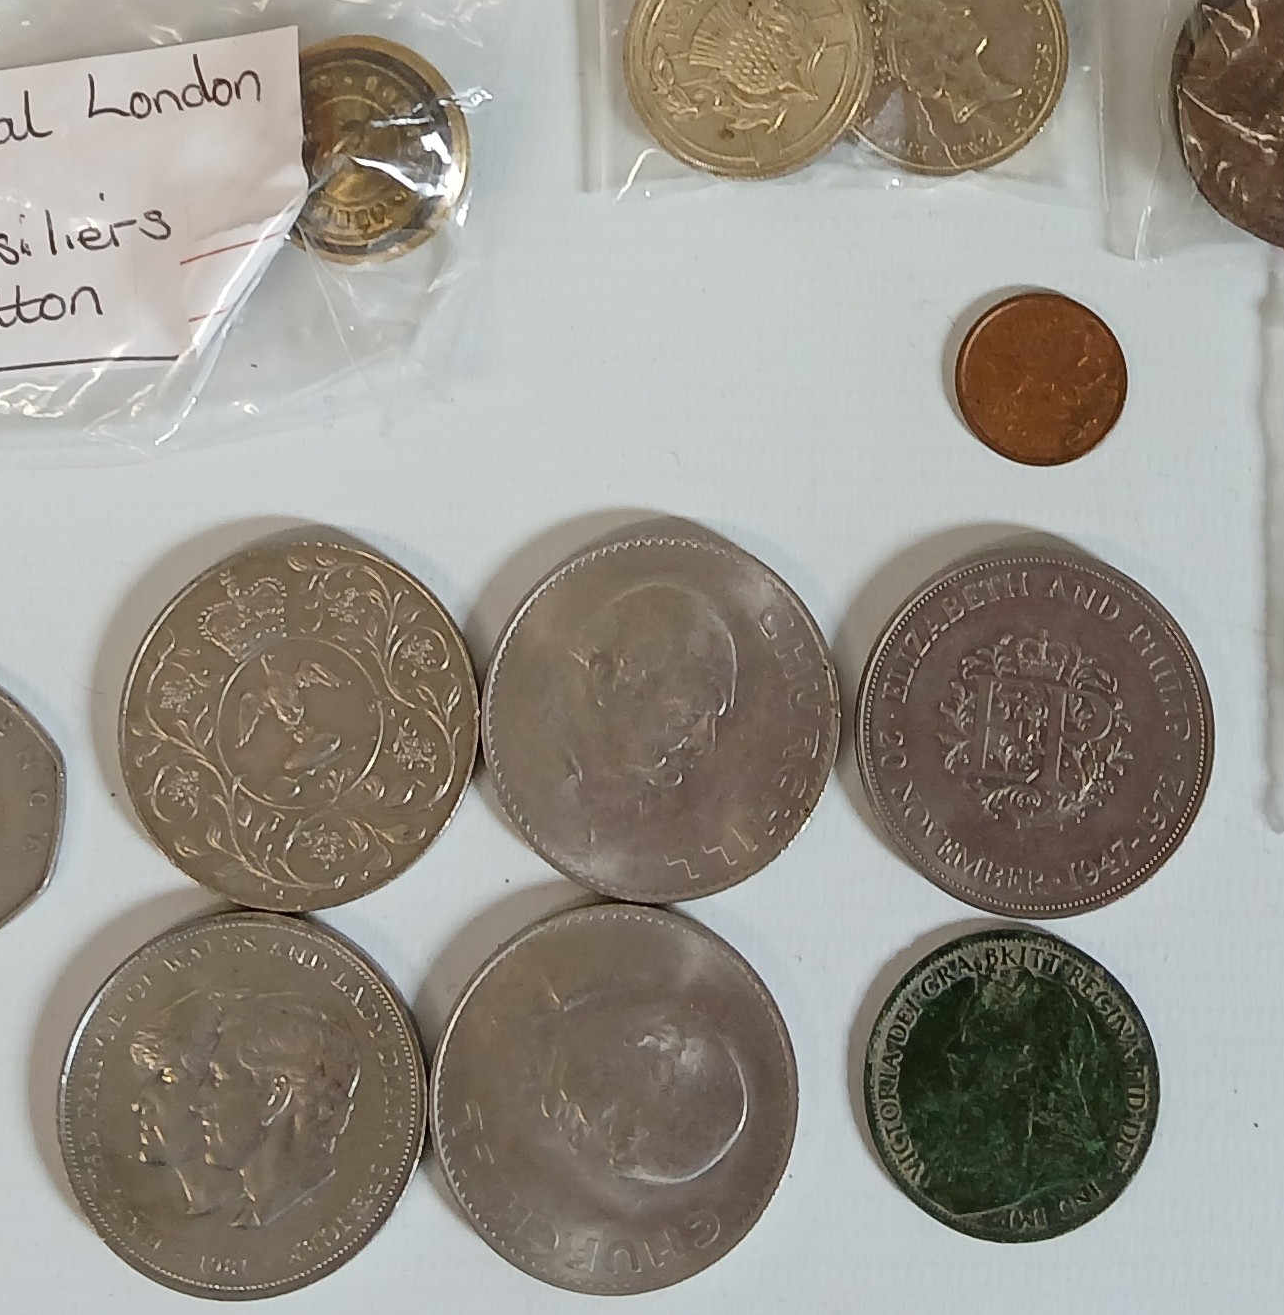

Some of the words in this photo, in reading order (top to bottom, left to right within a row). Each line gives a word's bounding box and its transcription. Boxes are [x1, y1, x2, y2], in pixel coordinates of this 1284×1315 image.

[86, 53, 262, 120] London
[882, 570, 1030, 704] ELIZABETH
[1047, 574, 1121, 622] AND
[887, 997, 923, 1047] DEI
[1068, 964, 1144, 1061] REGINA
[878, 1045, 927, 1187] VICTORIA
